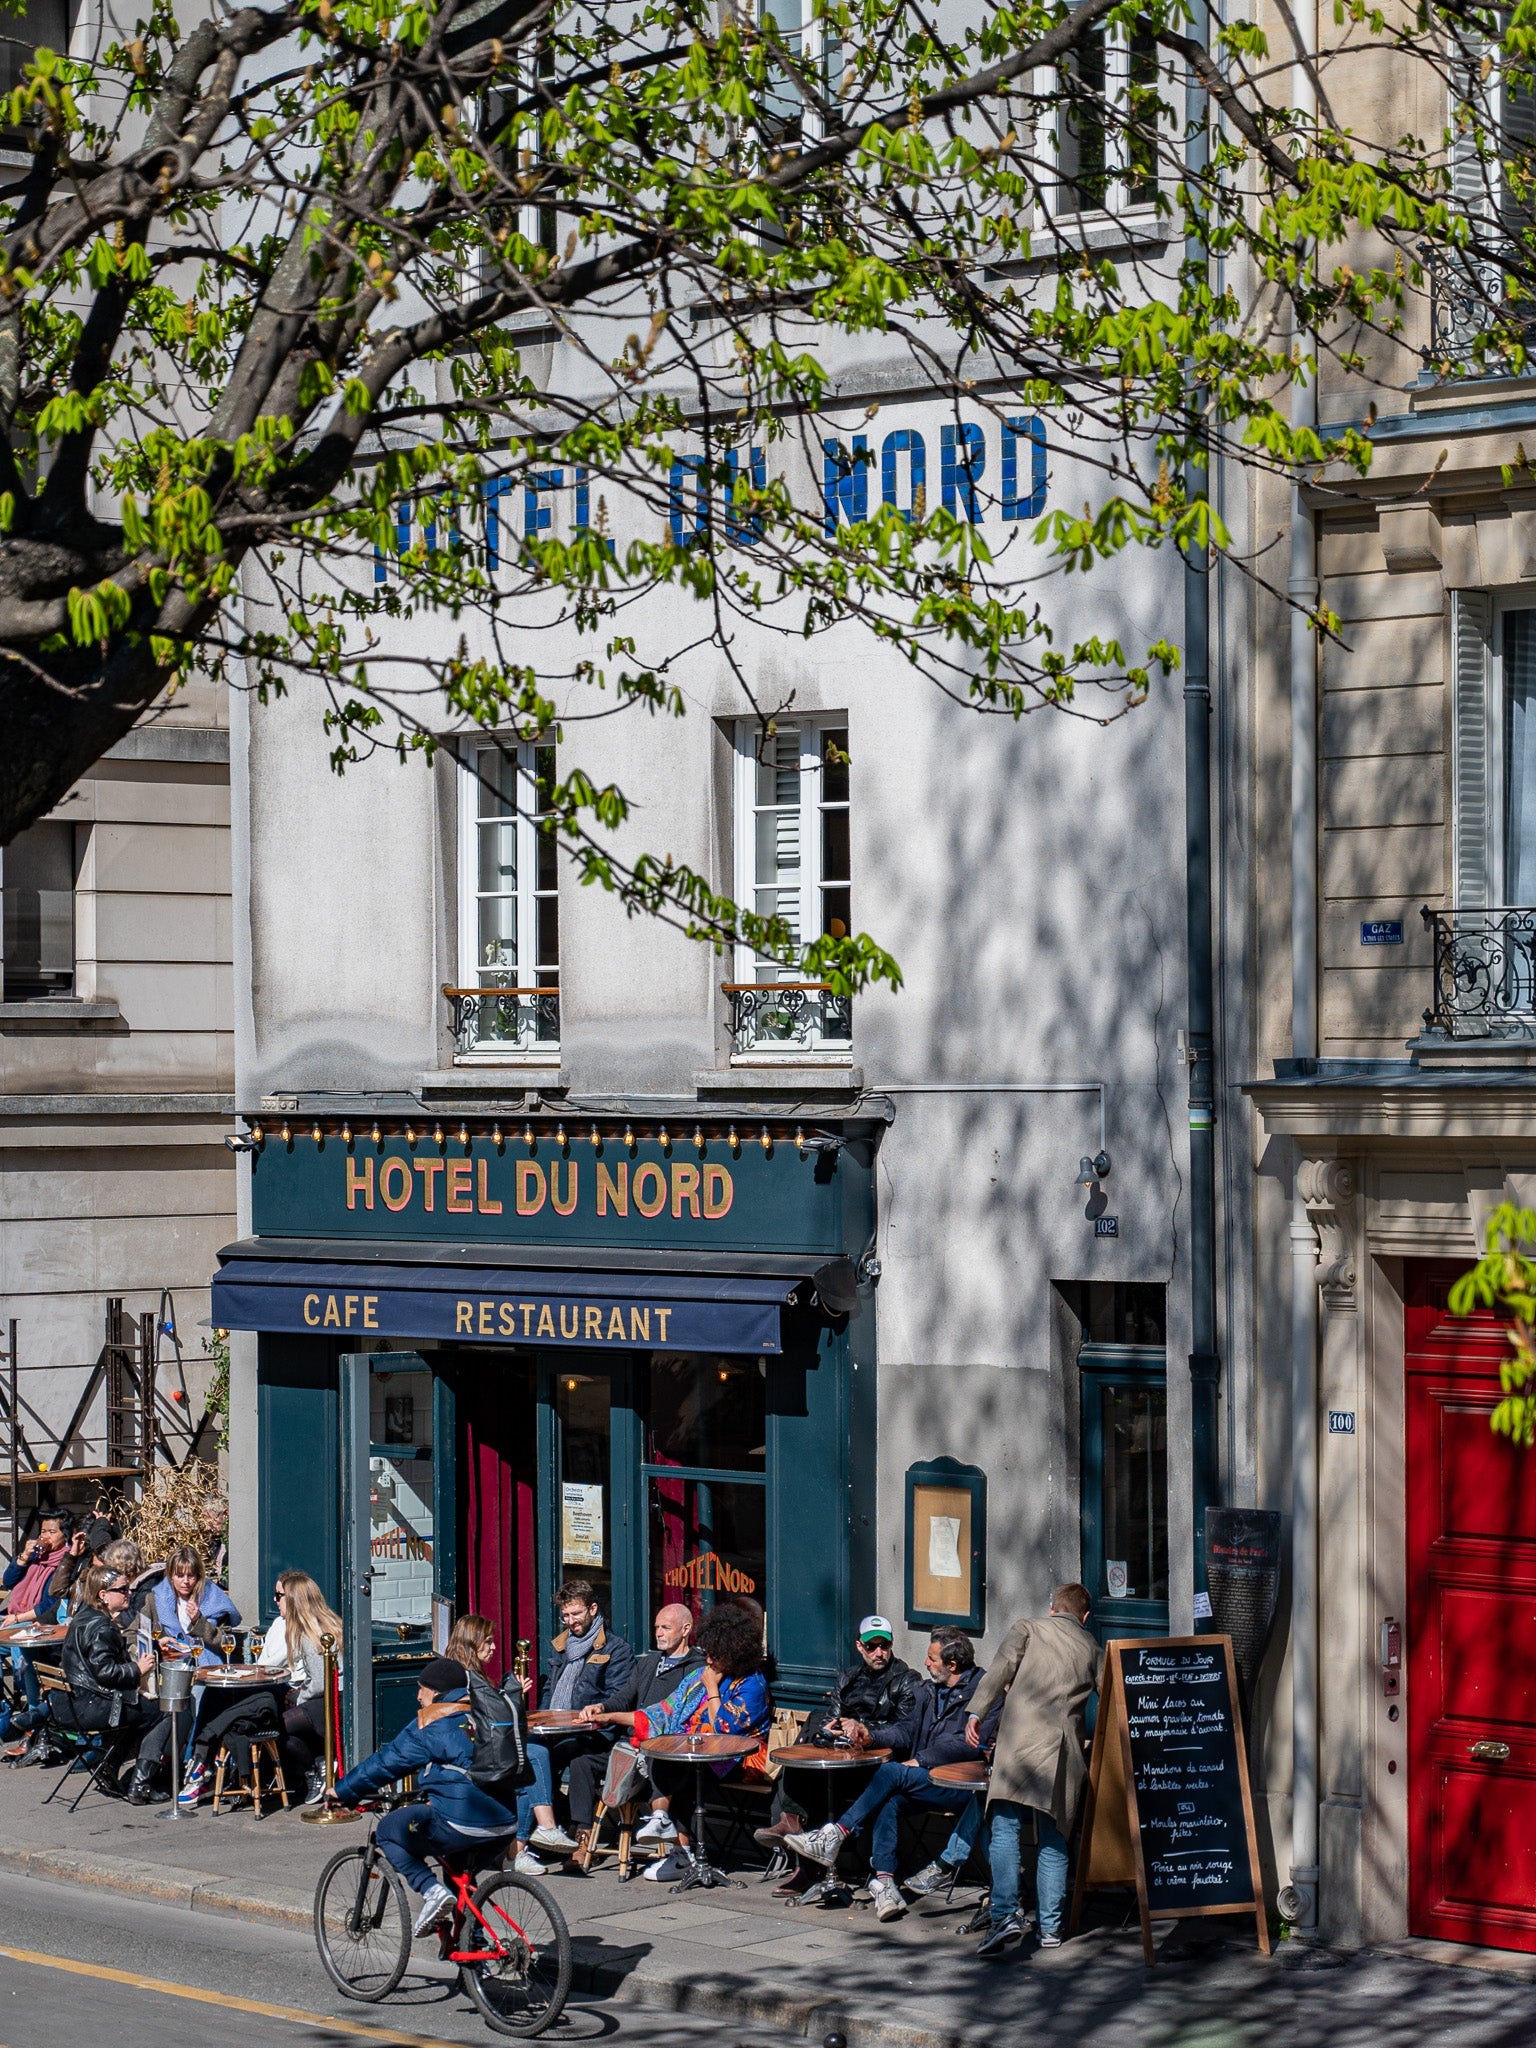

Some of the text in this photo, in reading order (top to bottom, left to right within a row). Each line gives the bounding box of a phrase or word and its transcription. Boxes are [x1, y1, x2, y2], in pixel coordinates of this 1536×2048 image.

[823, 415, 1048, 539] NORD
[1371, 923, 1391, 934] GAZ
[346, 1156, 734, 1220] HOTEL DU NORD
[1097, 1219, 1116, 1233] 102
[303, 1293, 672, 1342] CAFE RESTAURANT
[1332, 1414, 1352, 1430] 100
[716, 1556, 755, 1594] NORD
[1138, 1695, 1159, 1710] Mini
[1130, 1727, 1140, 1738] et
[1150, 1816, 1177, 1828] Moules
[1205, 1861, 1233, 1874] rouge
